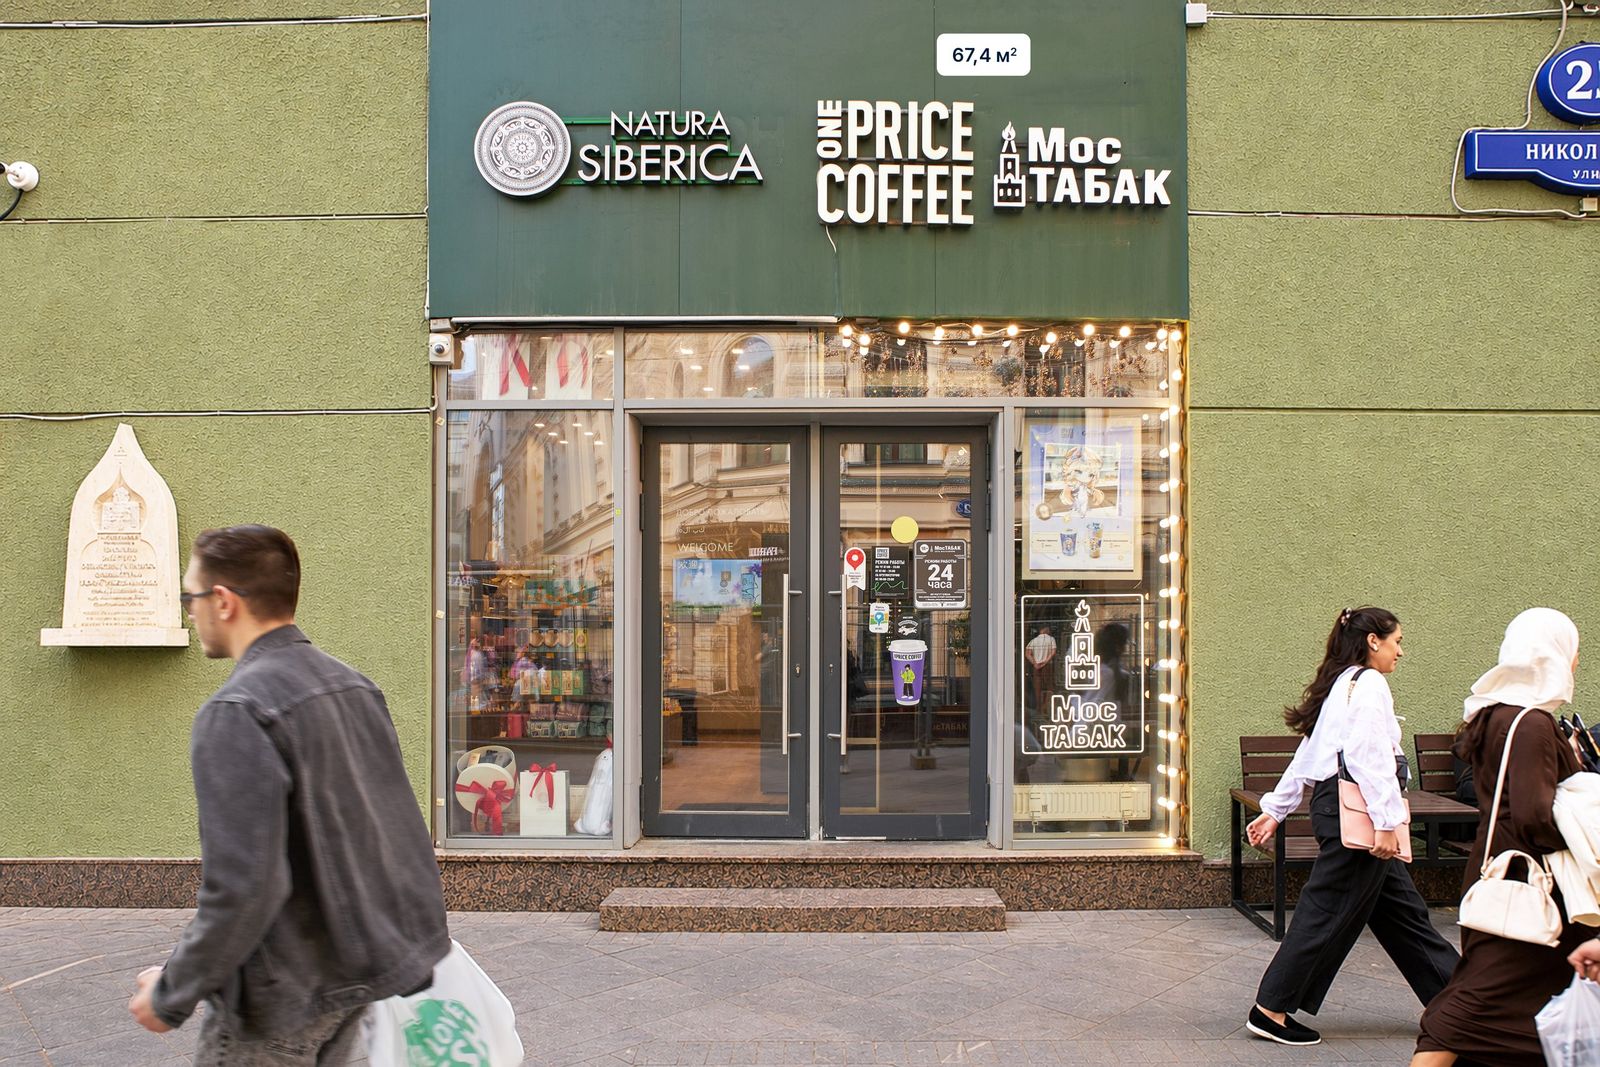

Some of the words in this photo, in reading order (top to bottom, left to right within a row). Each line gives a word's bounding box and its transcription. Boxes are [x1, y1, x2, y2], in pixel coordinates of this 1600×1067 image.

[1566, 60, 1600, 100] 2
[610, 110, 731, 136] NATURA
[816, 100, 842, 159] ONE
[848, 101, 974, 161] PRICE
[577, 143, 763, 182] SIBERICA
[1028, 127, 1122, 165] Мос
[1526, 143, 1598, 160] НИКОЛ
[816, 164, 974, 225] COFFEE
[1029, 167, 1172, 206] ТАБАК
[677, 542, 734, 552] WELCOME
[928, 564, 954, 581] 24
[1051, 694, 1117, 722] Мос
[1040, 724, 1127, 749] ТАБАК
